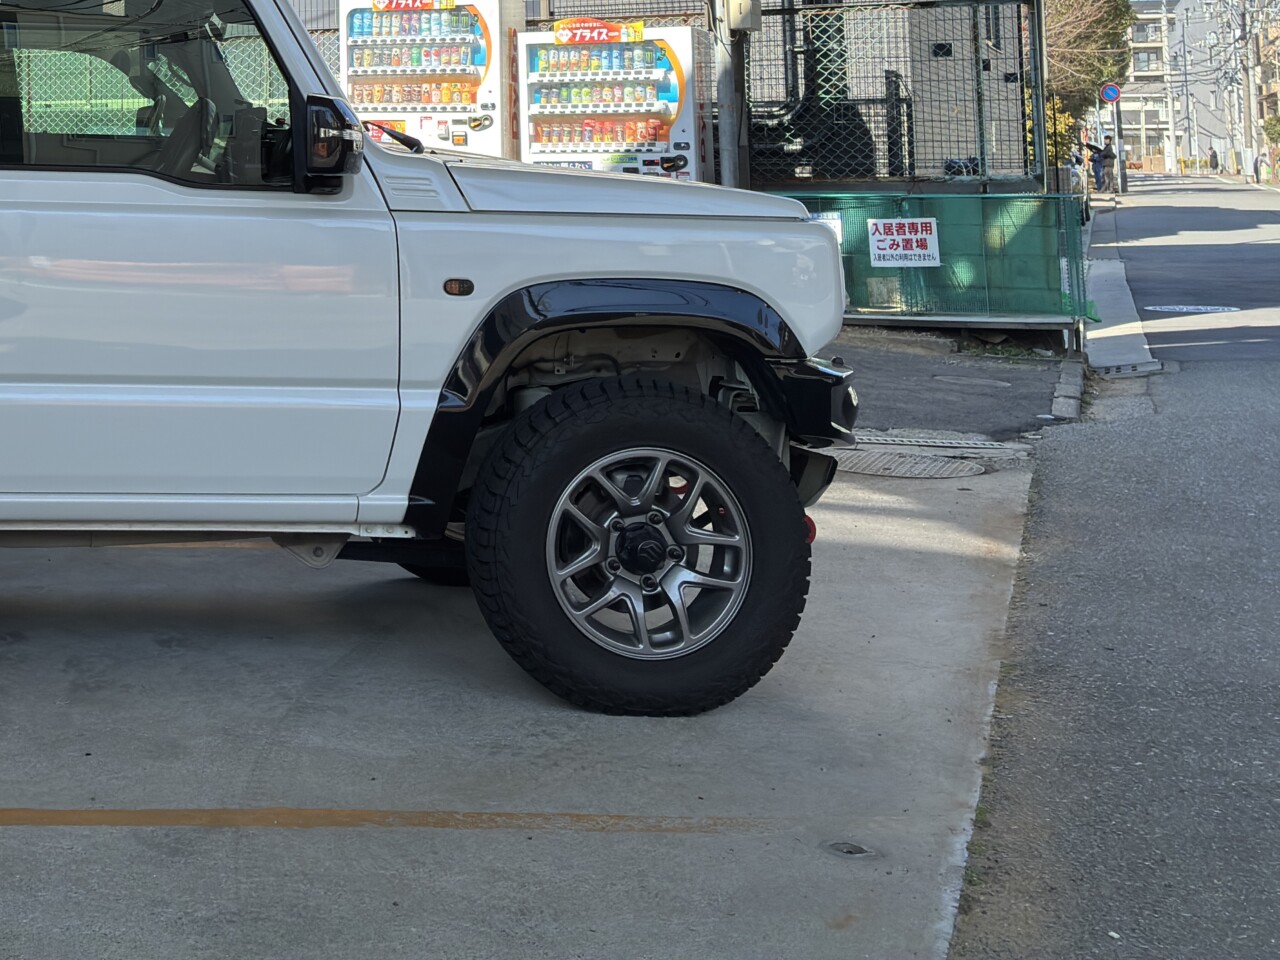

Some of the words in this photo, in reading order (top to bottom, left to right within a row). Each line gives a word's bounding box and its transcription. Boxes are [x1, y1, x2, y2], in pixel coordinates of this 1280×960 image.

[872, 222, 932, 236] 入居者専用
[876, 238, 928, 251] ごみ置場
[873, 253, 937, 262] 入居者以外の利用はできません
